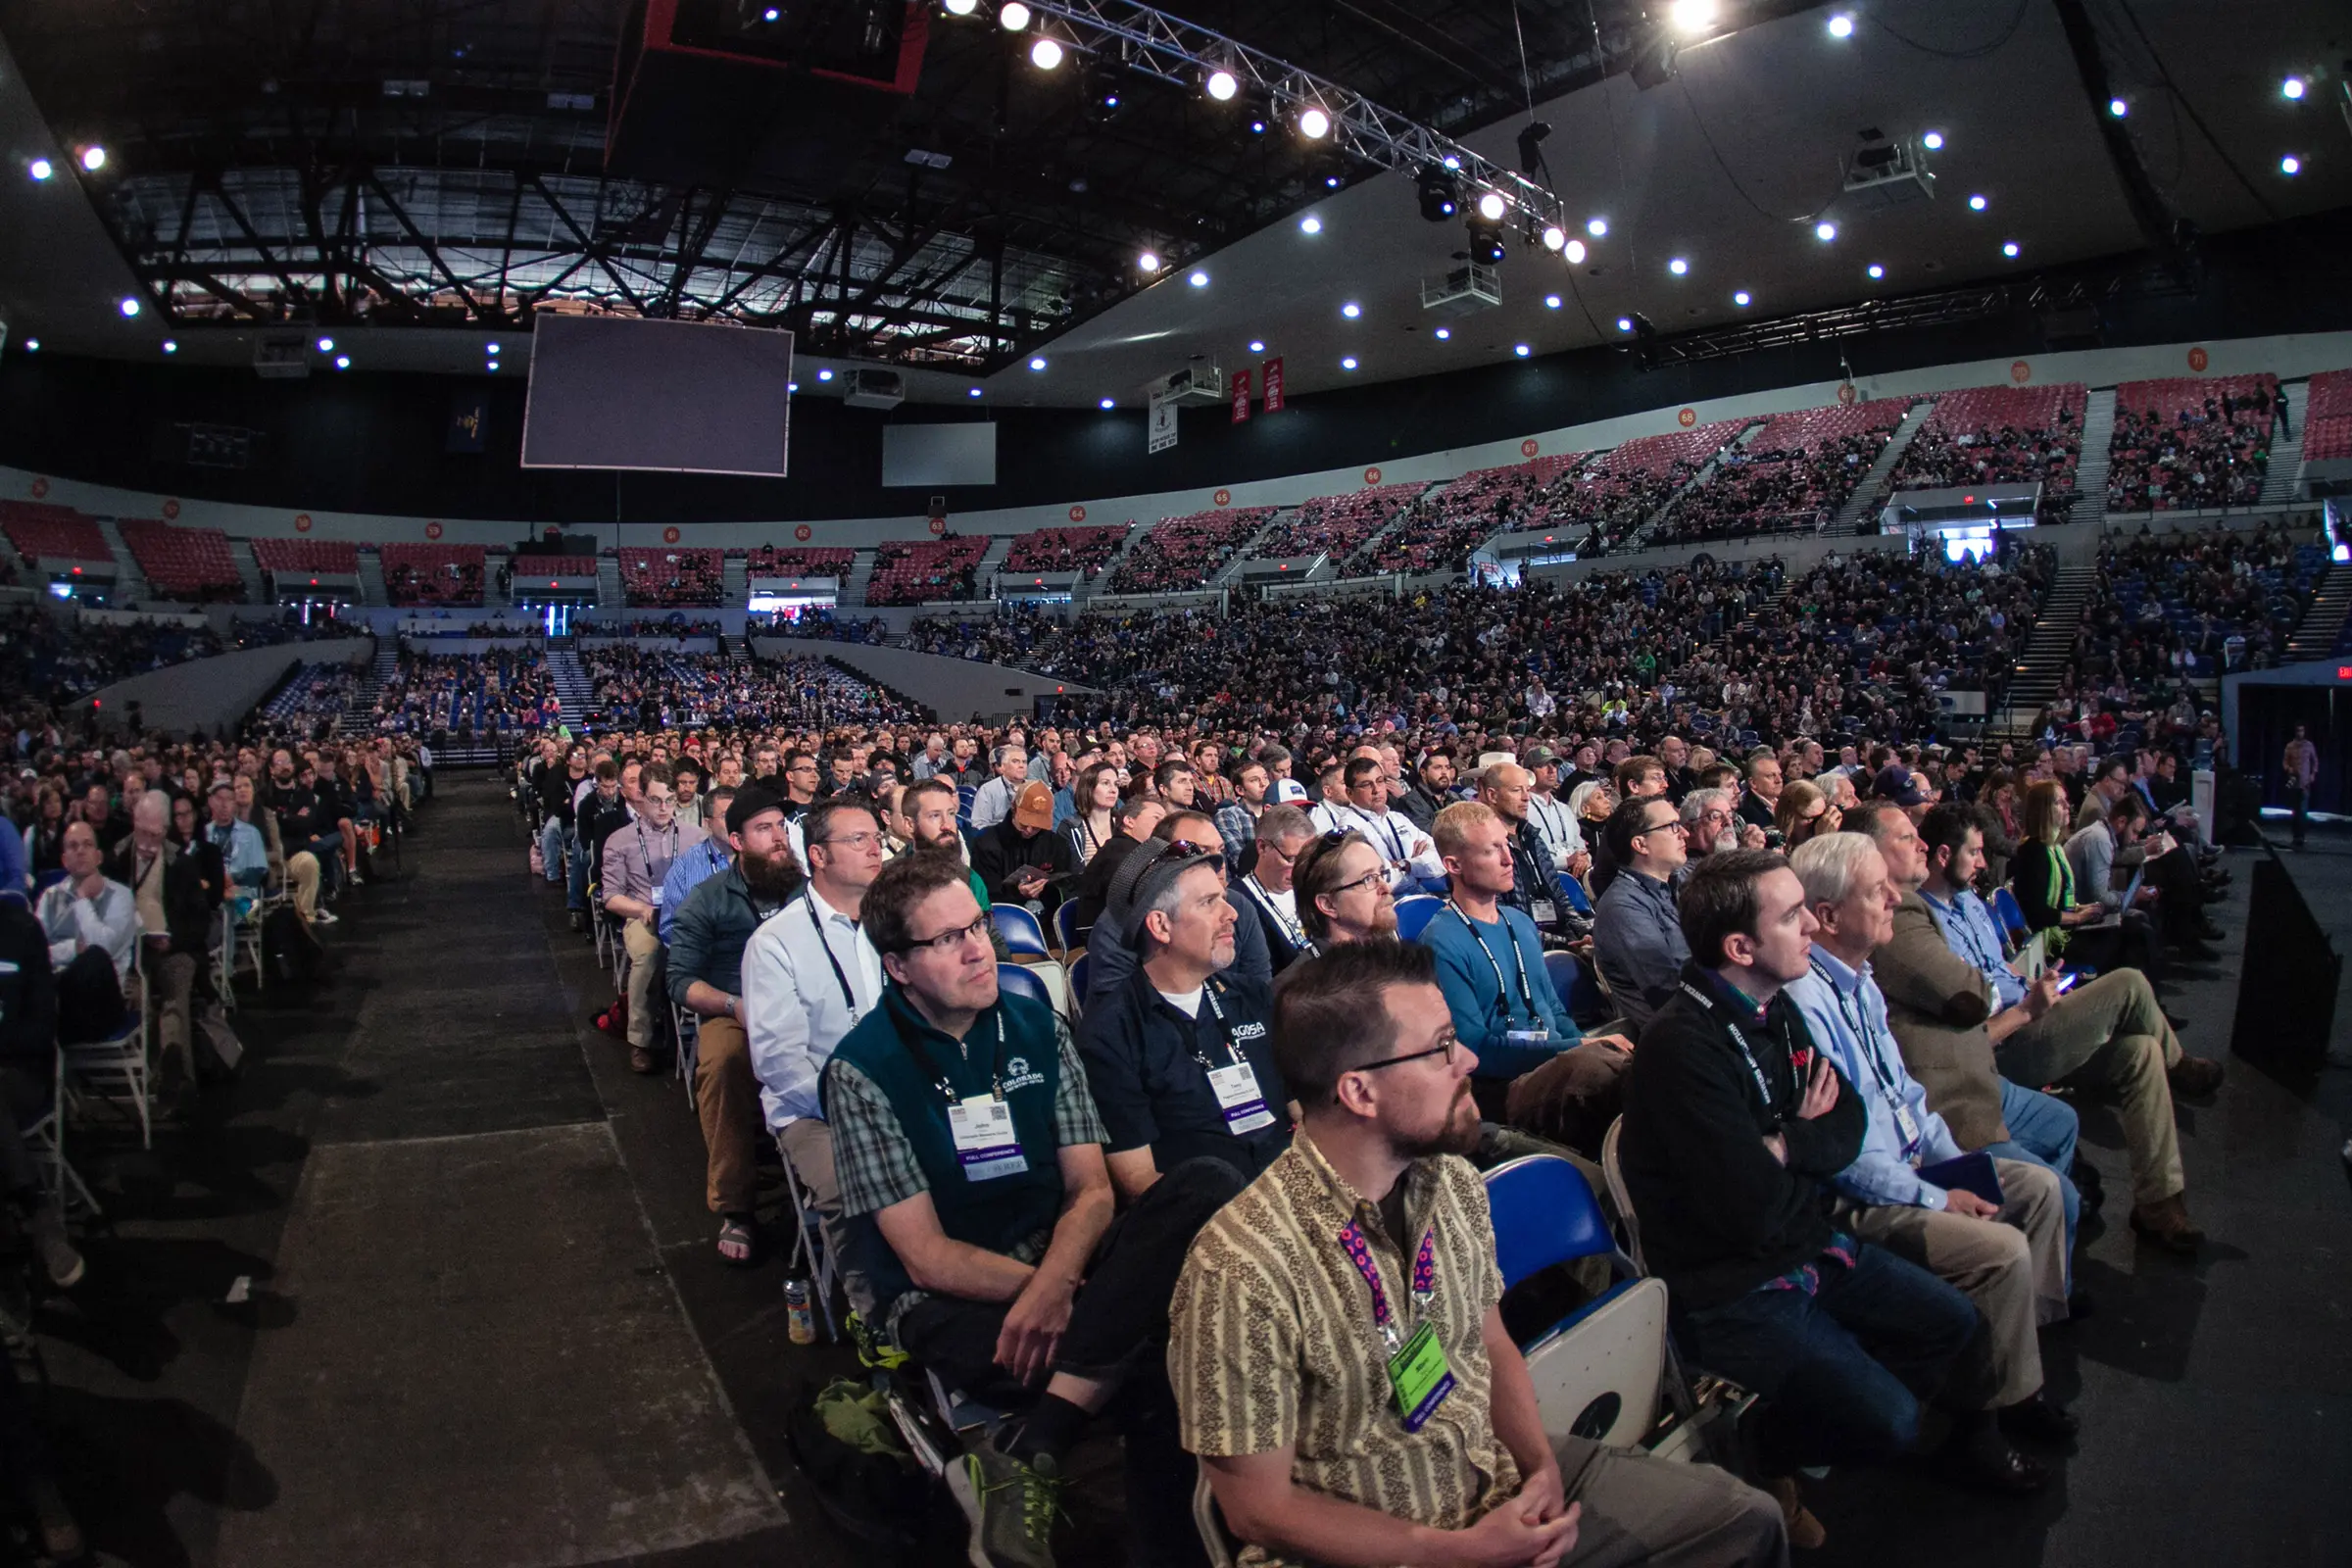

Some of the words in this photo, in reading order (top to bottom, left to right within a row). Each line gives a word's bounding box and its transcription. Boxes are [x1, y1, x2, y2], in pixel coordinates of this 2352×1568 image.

[2193, 355, 2204, 364] 71
[1525, 444, 1536, 453] 67
[1368, 471, 1379, 480] 66
[1072, 510, 1083, 518] 64
[932, 521, 943, 530] 63
[2339, 666, 2352, 678] EXI
[1003, 1072, 1045, 1089] COLORADO
[980, 1148, 1016, 1159] CONFERENCE
